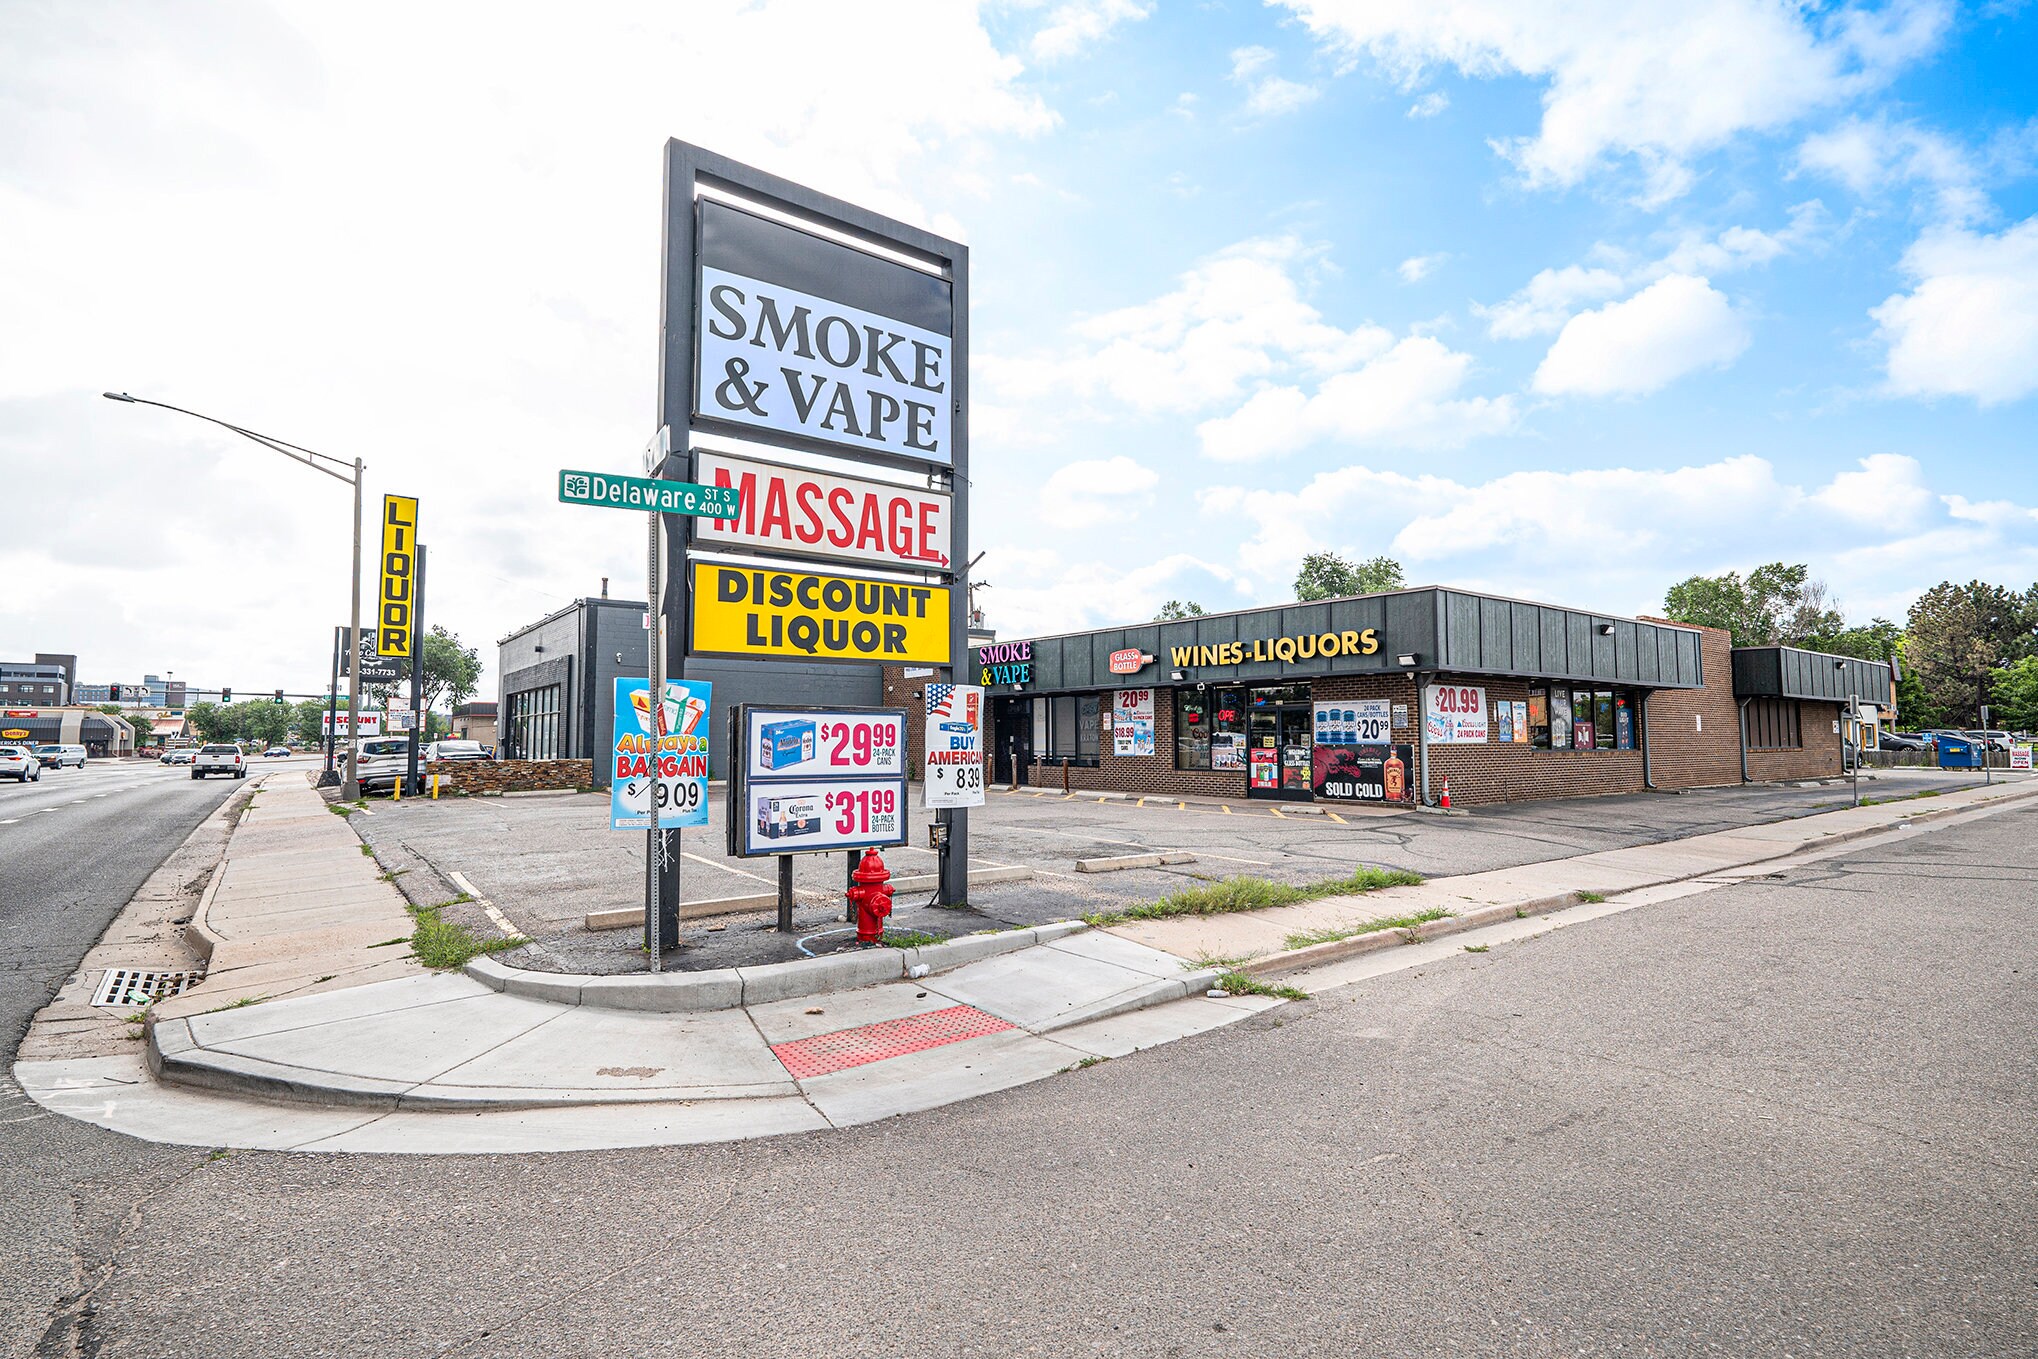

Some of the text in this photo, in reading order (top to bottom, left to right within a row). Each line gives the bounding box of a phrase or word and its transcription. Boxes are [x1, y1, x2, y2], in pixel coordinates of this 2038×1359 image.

[709, 285, 944, 394] SMOKE
[715, 357, 938, 452] & VAPE
[593, 477, 731, 510] Delaware ST S
[699, 502, 736, 516] 400 W
[714, 468, 940, 559] MASSAGE
[382, 502, 412, 652] LIQUOR
[718, 569, 931, 618] DISCOUNT
[747, 613, 907, 654] LIQUOR
[979, 642, 1031, 664] SMOKE
[1114, 652, 1135, 661] GLASS
[1113, 660, 1137, 671] BOTTLE
[981, 664, 1030, 686] & VAPE
[1435, 687, 1479, 713] $20.99
[1457, 730, 1486, 738] 24 PACK CANS
[699, 738, 708, 752] a
[950, 736, 975, 750] BUY
[873, 748, 896, 756] 24-PACK
[928, 751, 983, 765] AMERICAN
[876, 757, 892, 765] CANS
[937, 767, 980, 791] $ 8.39
[1325, 782, 1383, 798] SOLD COLD
[872, 815, 895, 824] 24-PACK
[872, 823, 895, 833] BOTTLES
